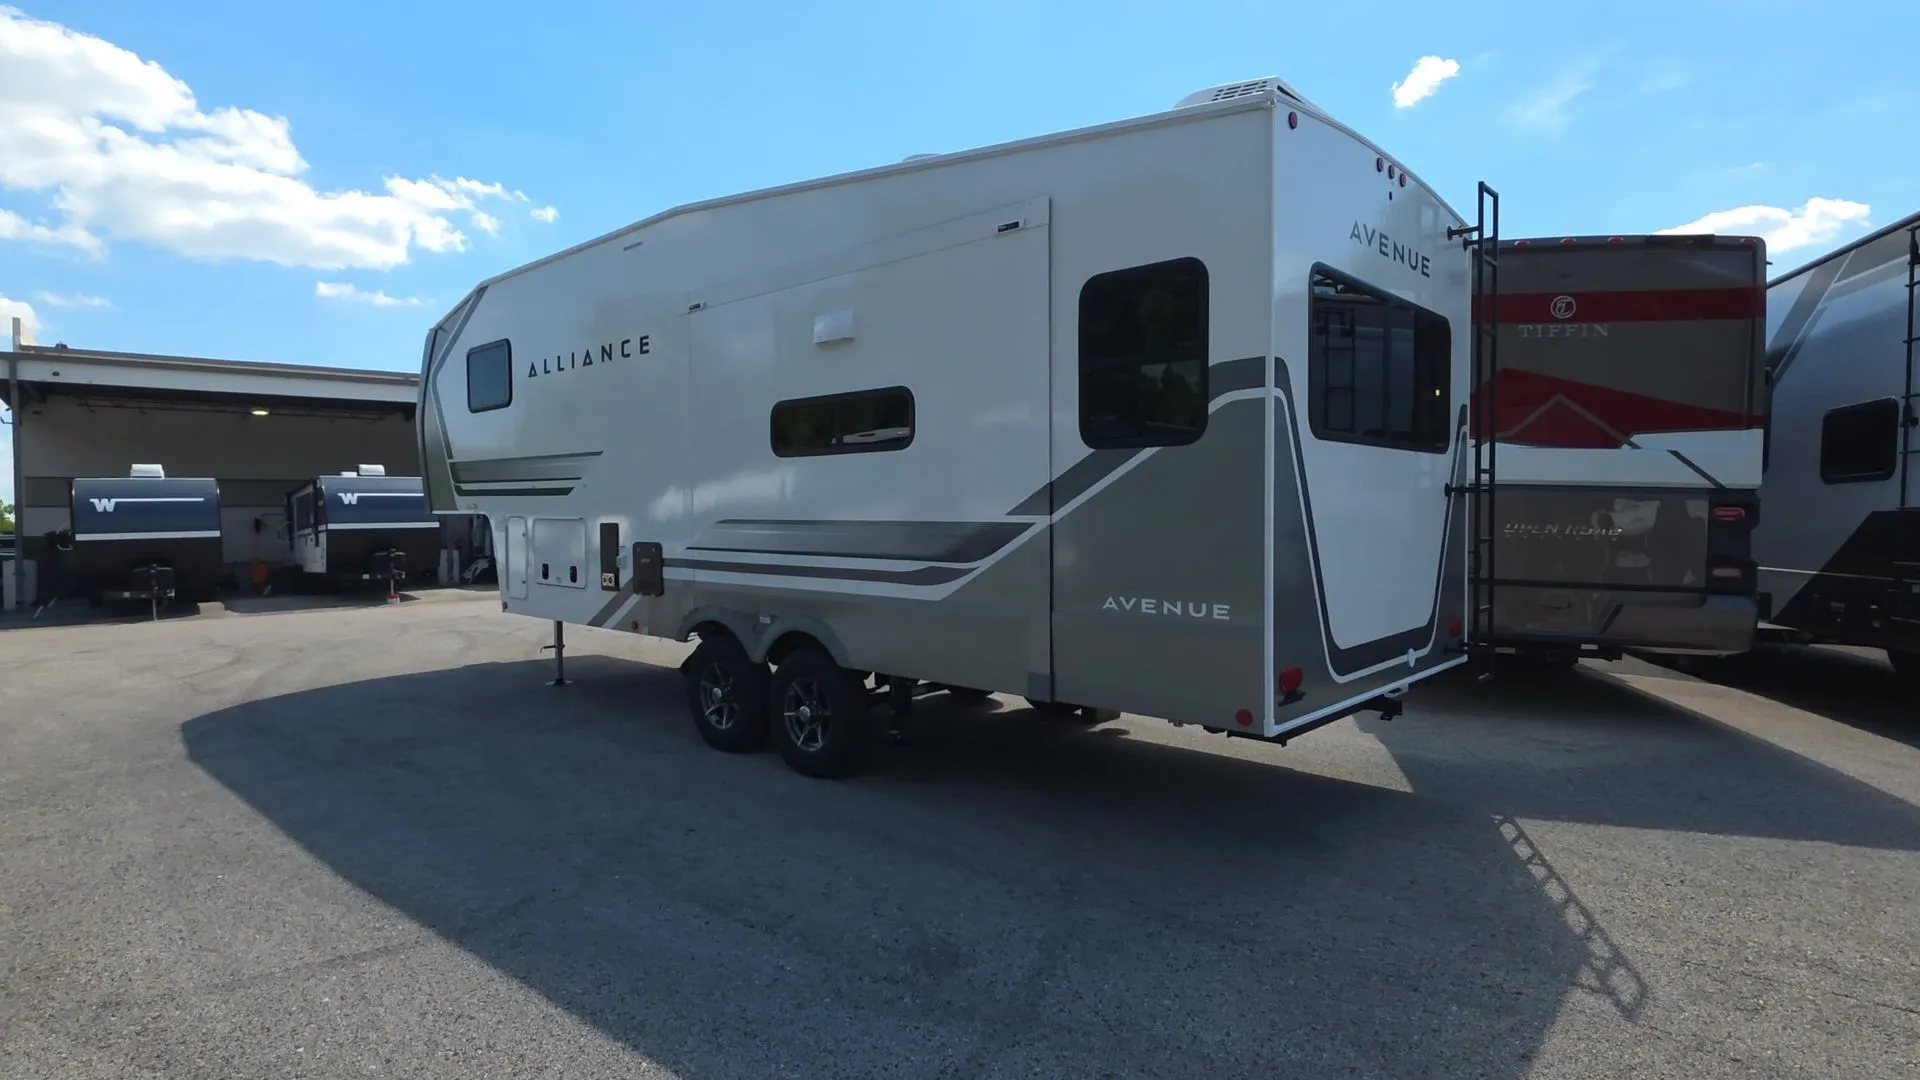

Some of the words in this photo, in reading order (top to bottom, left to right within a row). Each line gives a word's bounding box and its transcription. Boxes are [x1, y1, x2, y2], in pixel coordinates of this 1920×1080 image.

[1350, 219, 1430, 278] AVENUE
[1518, 324, 1609, 338] TIFFIN
[528, 335, 650, 378] ALLIANCE
[89, 498, 117, 512] W
[337, 493, 359, 505] W
[1102, 596, 1231, 620] AVENUE
